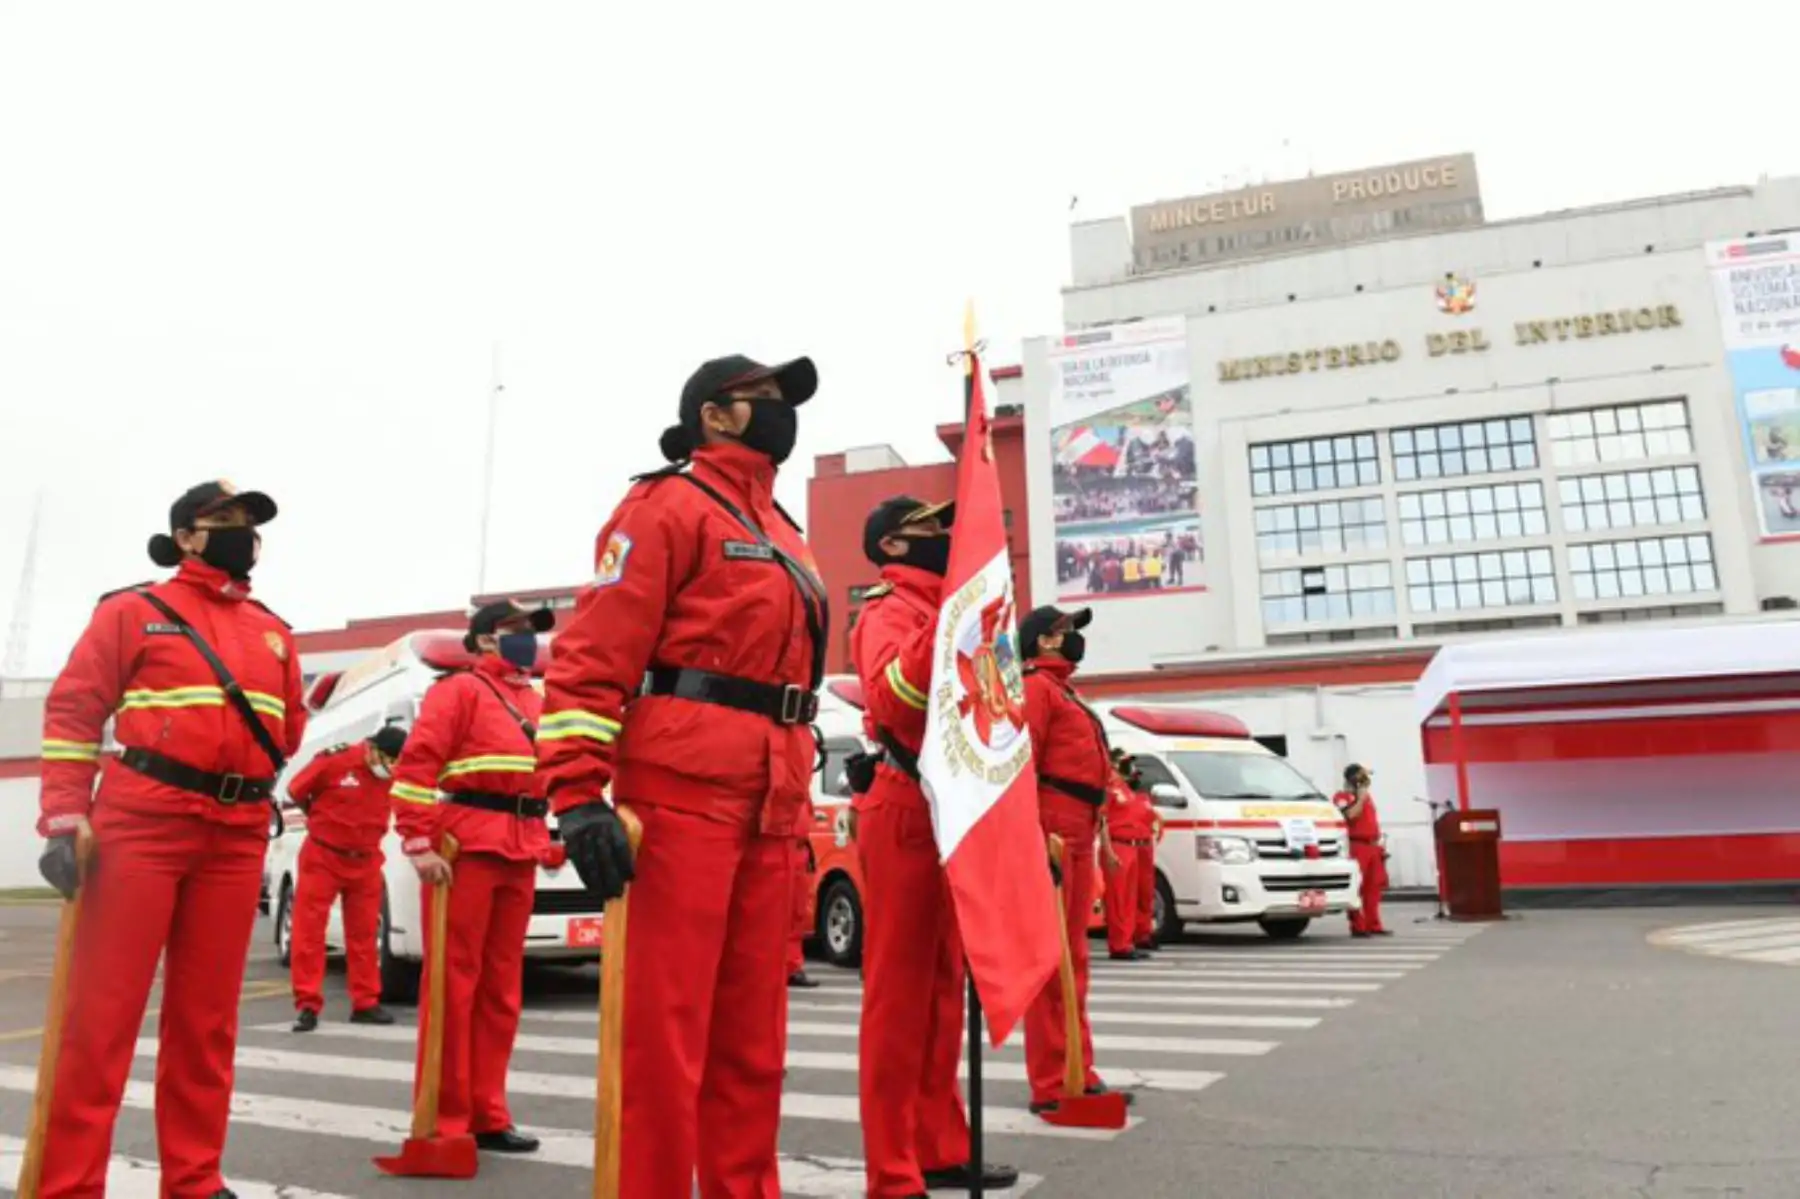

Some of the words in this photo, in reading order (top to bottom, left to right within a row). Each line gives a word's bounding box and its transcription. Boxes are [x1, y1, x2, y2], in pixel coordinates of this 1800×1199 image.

[1149, 192, 1277, 232] MINCETUR
[1332, 163, 1459, 202] PRODUCE
[1217, 338, 1402, 384] MINISTERIO
[1426, 328, 1491, 357] DEL
[1514, 304, 1683, 346] INTERIOR
